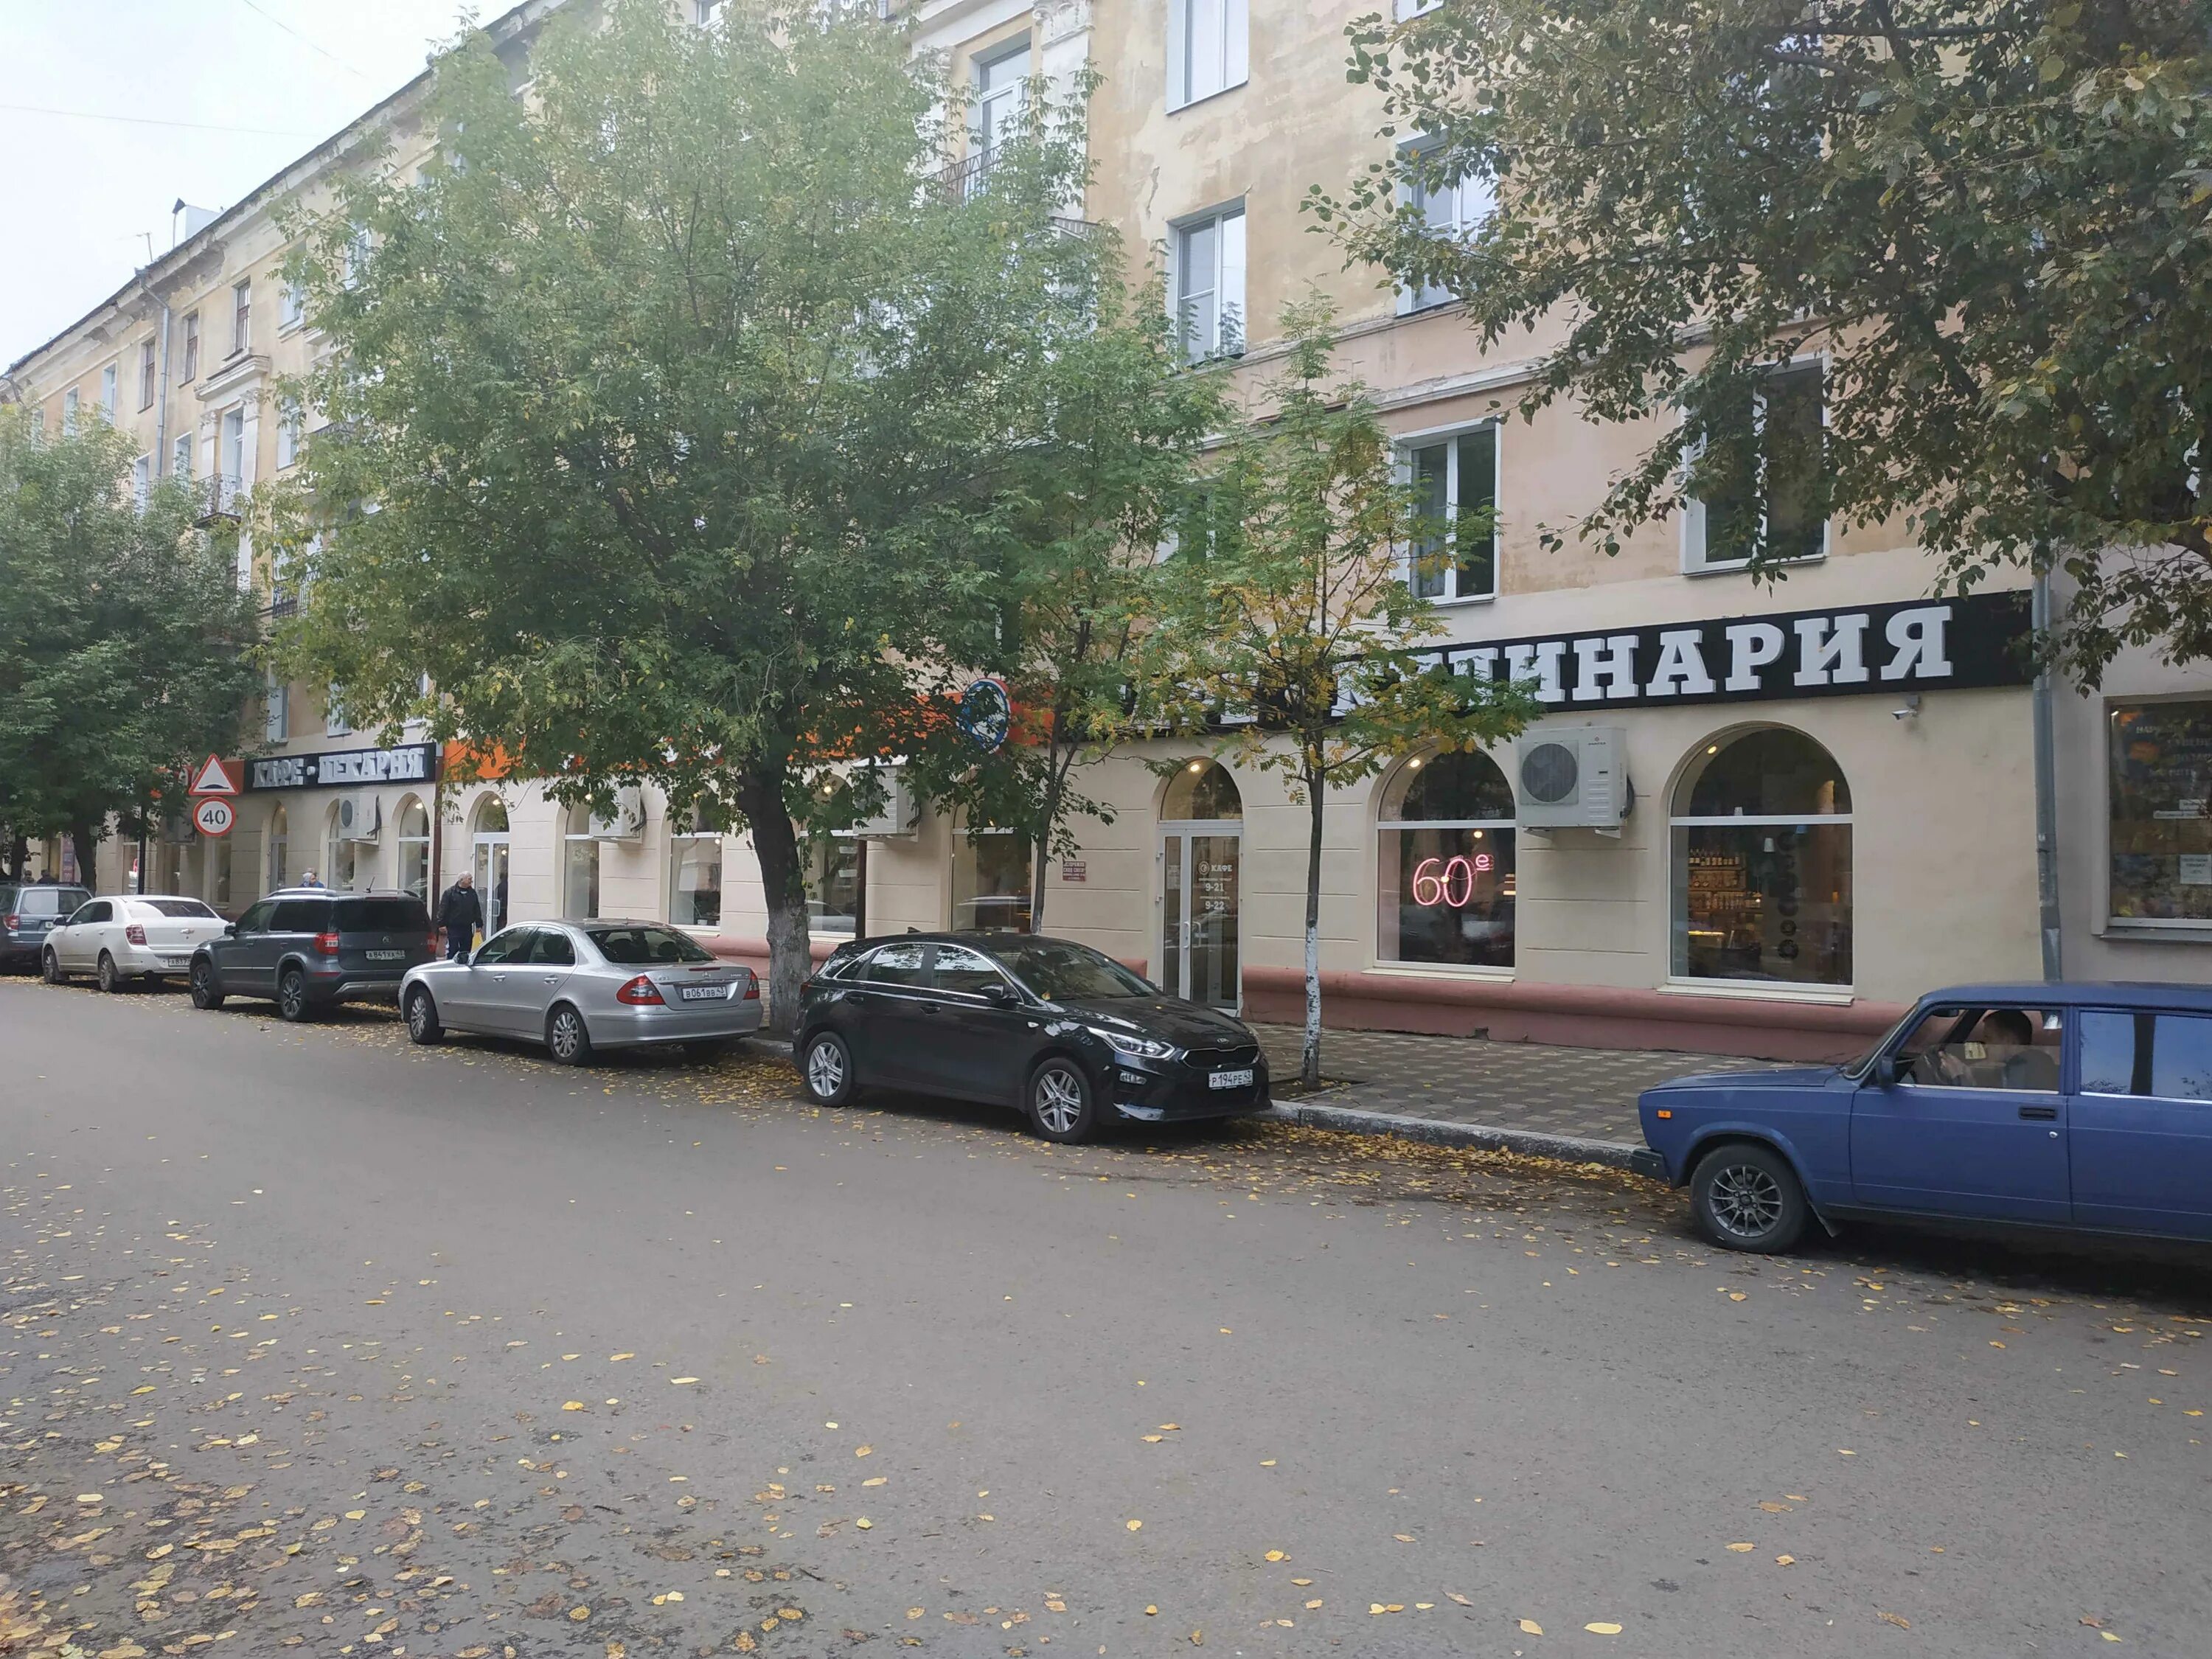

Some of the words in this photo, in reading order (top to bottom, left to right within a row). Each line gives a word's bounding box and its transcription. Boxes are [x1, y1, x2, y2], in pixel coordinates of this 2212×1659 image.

[253, 758, 304, 787] КАФЕ
[318, 748, 425, 784] ПЕКАРНЯ
[202, 810, 226, 825] 40
[1211, 864, 1233, 872] КАФЕ
[1206, 883, 1224, 891] 9-21
[1205, 901, 1225, 910] 9-22
